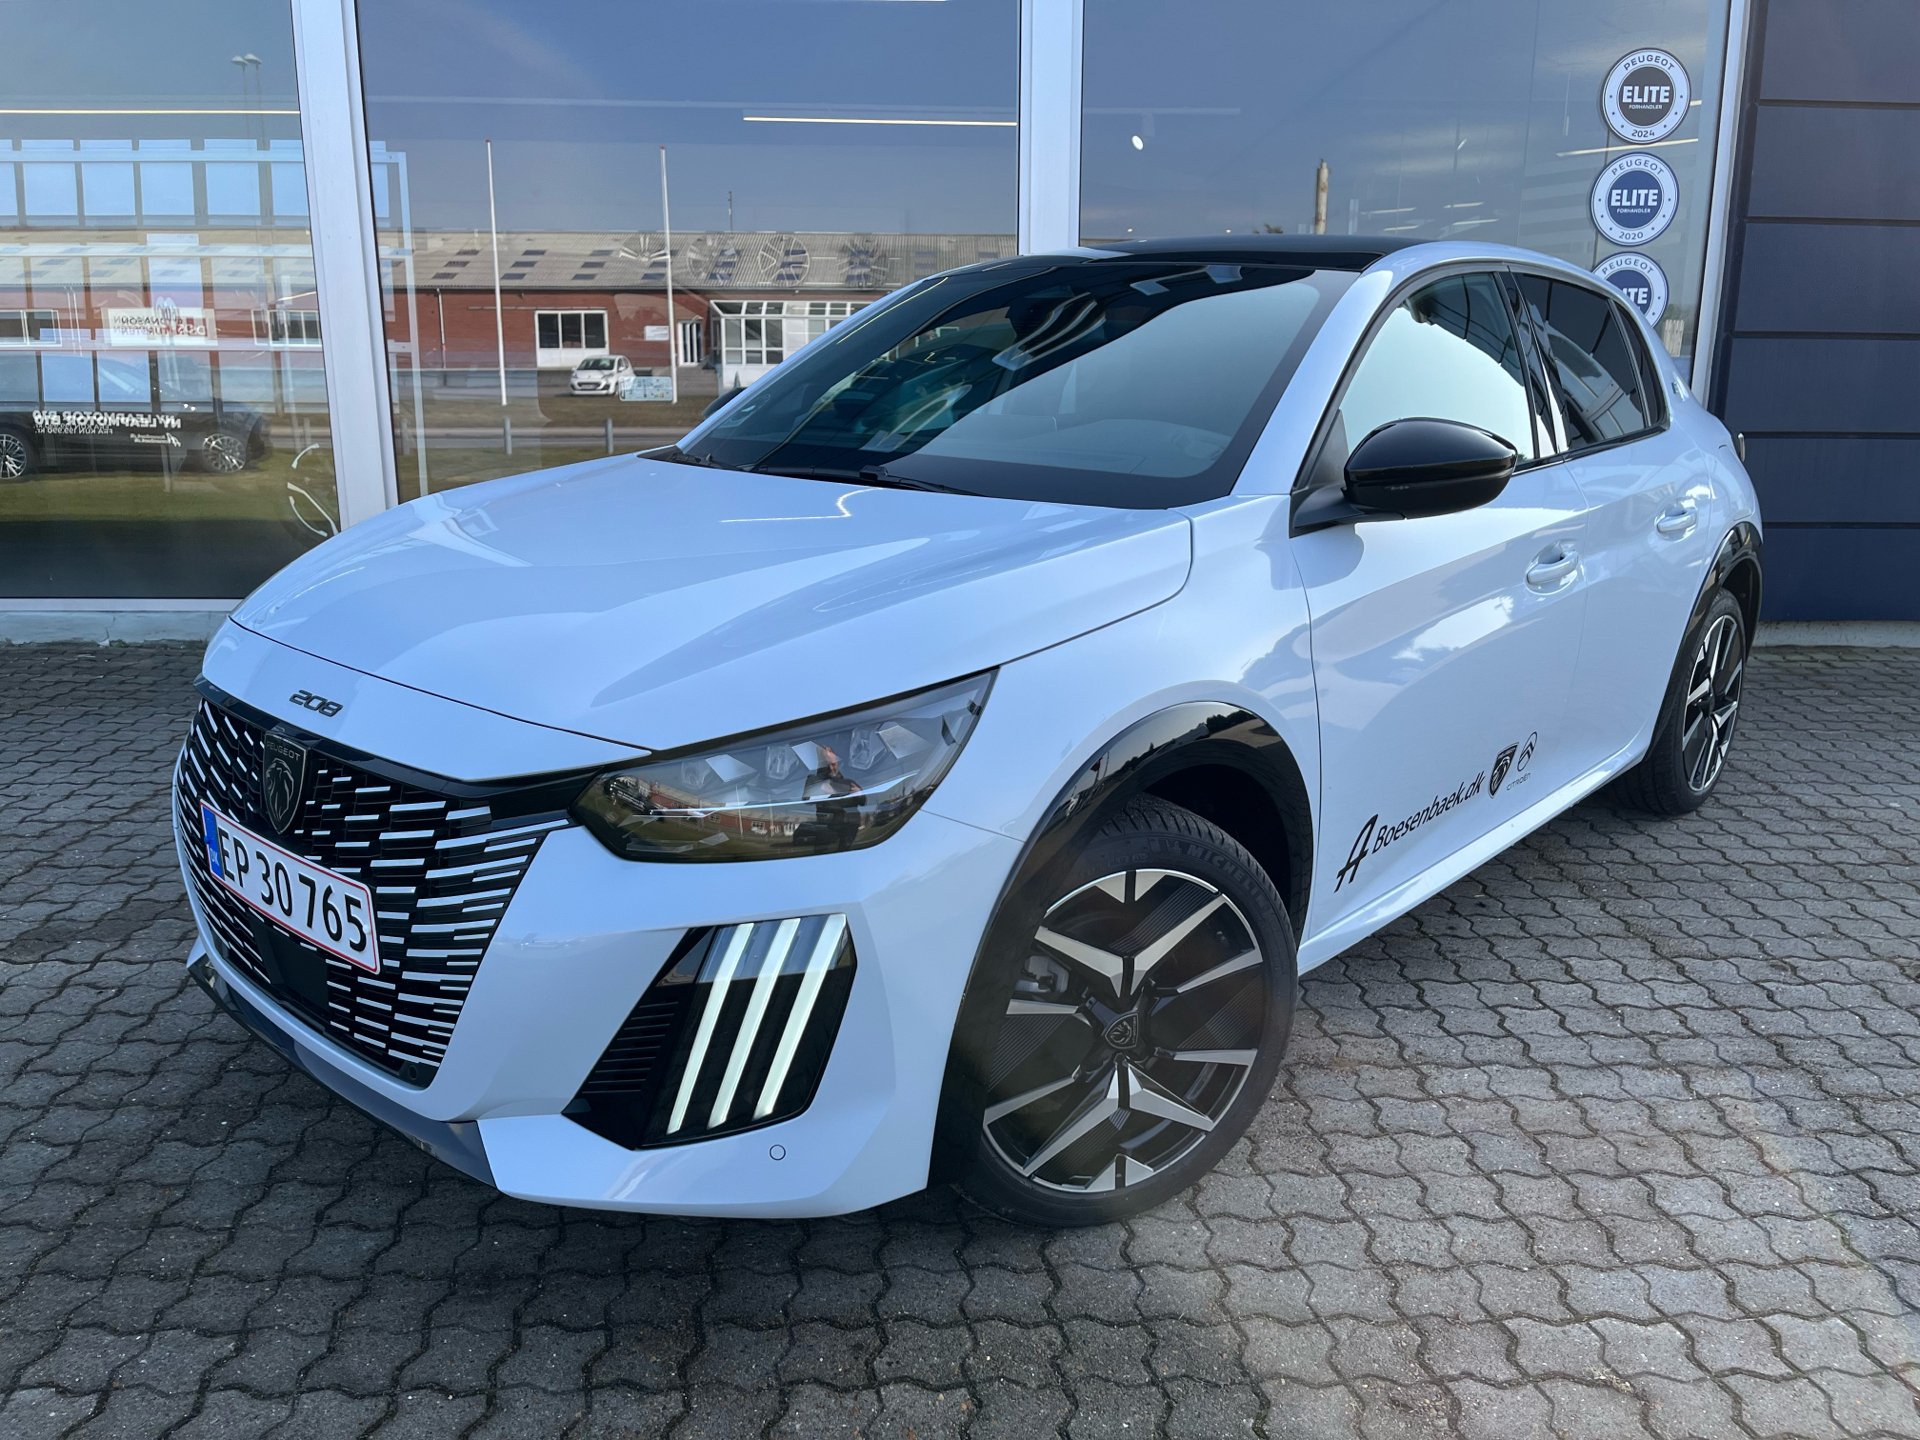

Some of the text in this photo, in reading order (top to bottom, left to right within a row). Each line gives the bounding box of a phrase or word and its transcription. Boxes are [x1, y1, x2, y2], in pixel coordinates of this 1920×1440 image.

[1623, 54, 1675, 71] PEUGEOT
[1622, 85, 1671, 103] ELITE
[1631, 129, 1655, 138] 2024
[1611, 158, 1665, 176] PEUGEOT
[1610, 189, 1659, 207] ELITE
[1618, 231, 1644, 240] 2020
[1601, 257, 1654, 275] PEUGEOT
[289, 689, 344, 717] 208
[266, 741, 301, 761] PEUGEOT
[1372, 771, 1486, 854] Boesenbaek.dk
